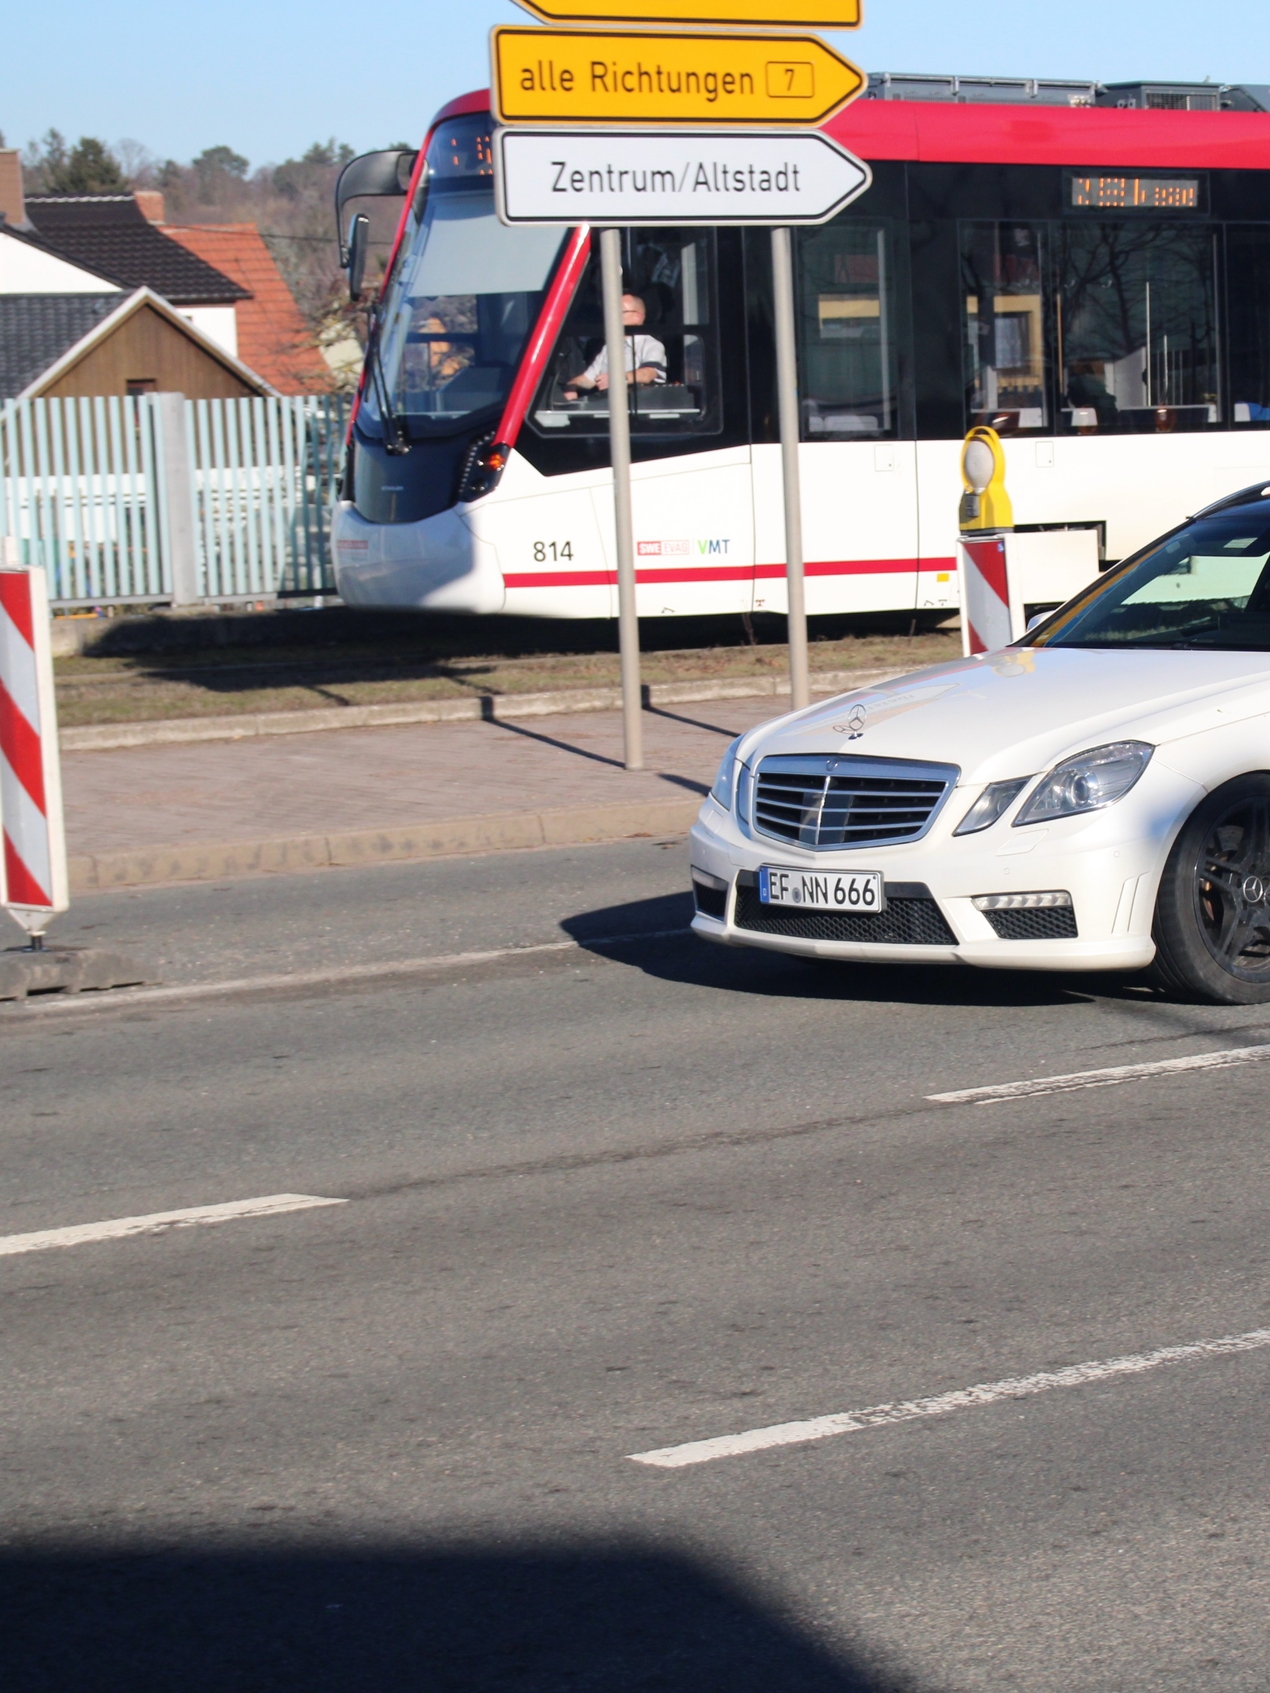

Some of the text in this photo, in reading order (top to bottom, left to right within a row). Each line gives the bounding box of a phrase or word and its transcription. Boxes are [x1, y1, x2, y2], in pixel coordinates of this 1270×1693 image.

[520, 60, 796, 103] alle Richtungen 7
[551, 161, 801, 193] Zentrum/Altstadt
[533, 540, 574, 562] 814
[639, 542, 689, 554] SWE EVAG
[697, 539, 731, 555] VMT
[769, 872, 876, 906] EF NN 666
